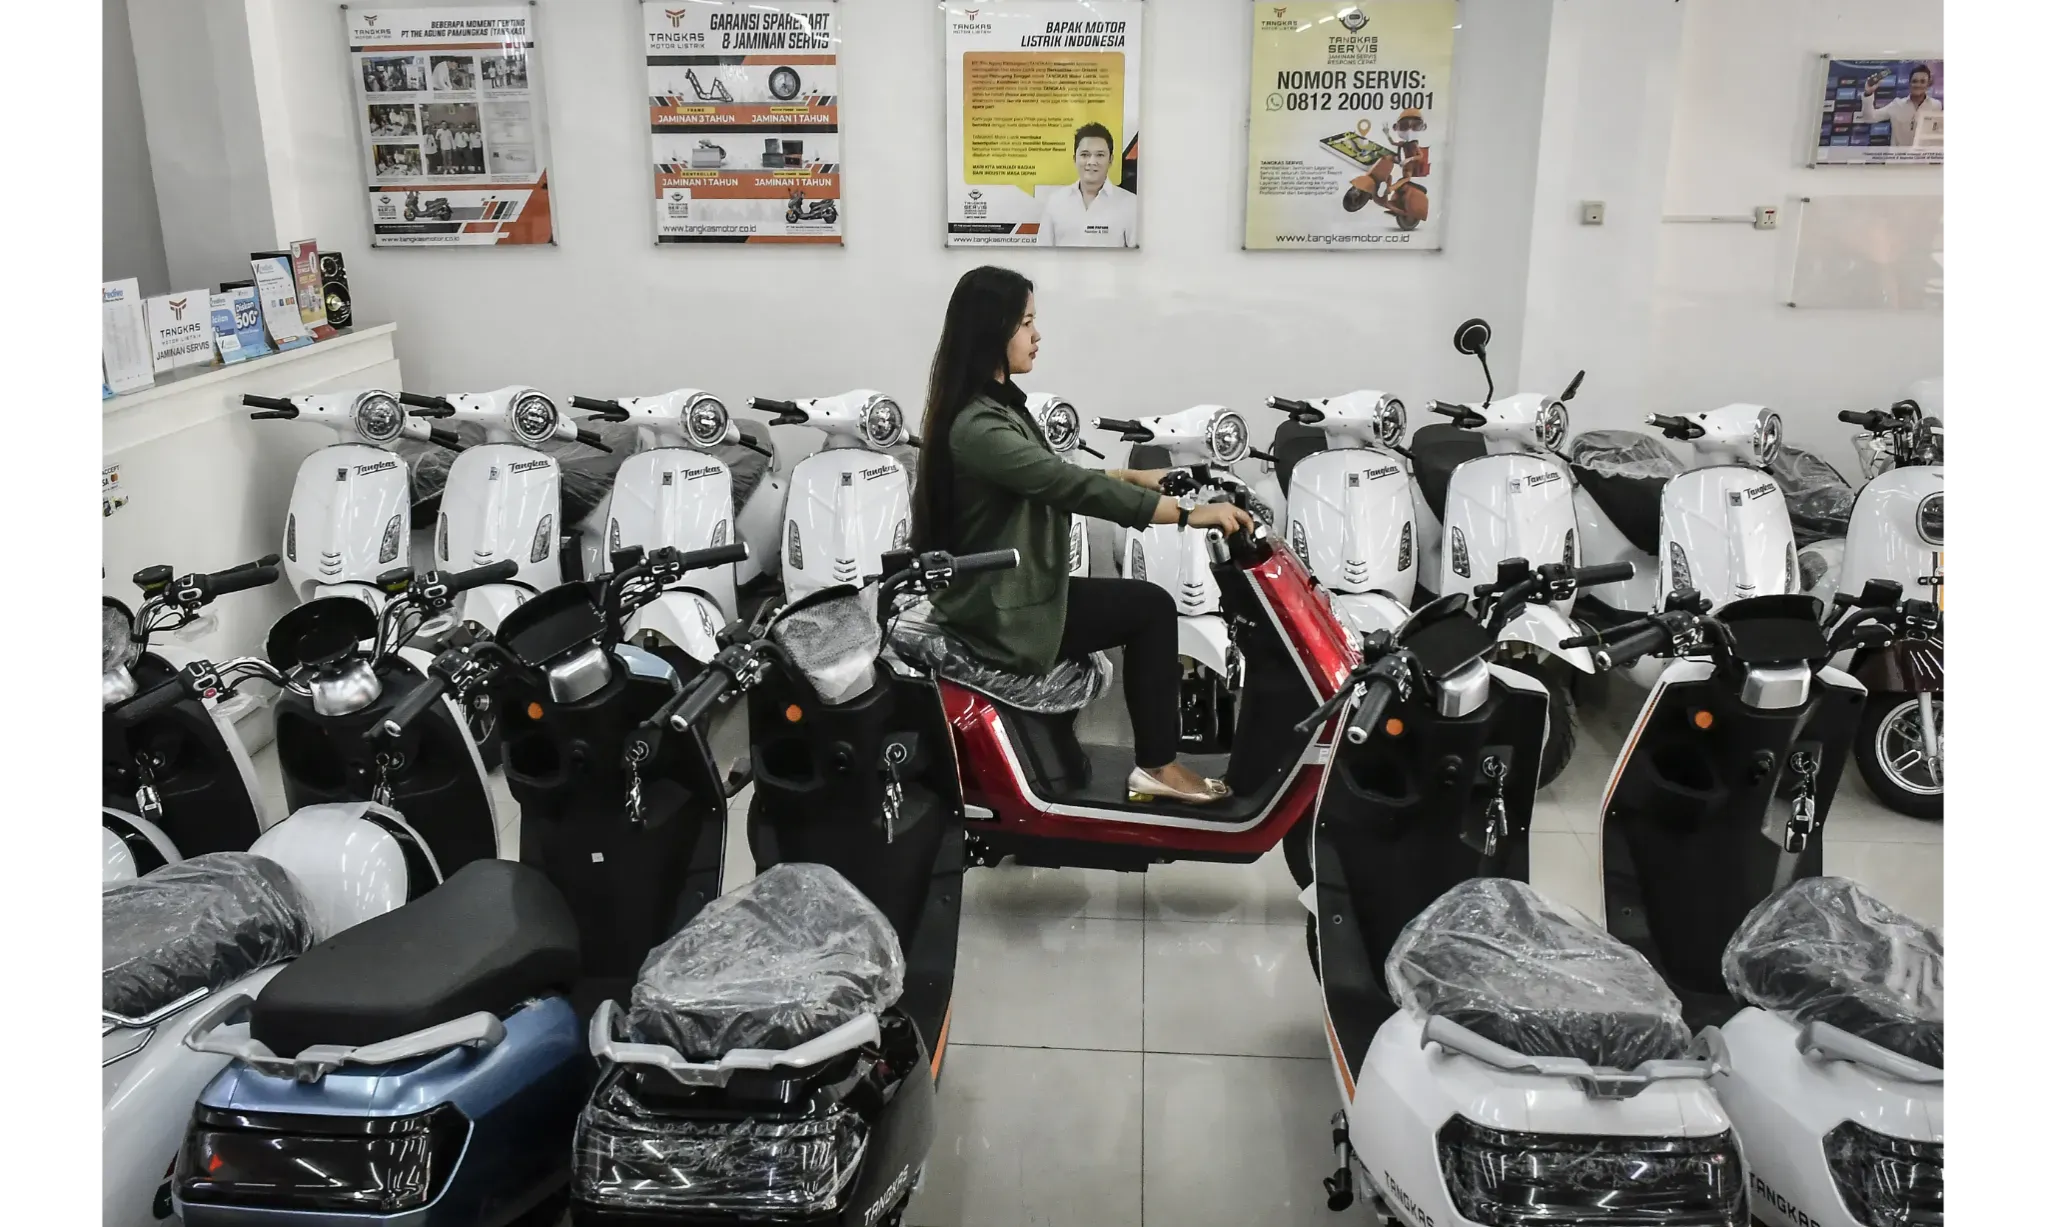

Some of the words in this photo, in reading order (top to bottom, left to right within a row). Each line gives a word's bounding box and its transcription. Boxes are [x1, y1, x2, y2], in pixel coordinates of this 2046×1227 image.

[431, 21, 464, 29] BEBERAPA
[466, 20, 495, 28] MOMENT
[710, 13, 760, 30] GARANSI
[401, 30, 409, 38] PT
[411, 30, 422, 38] THE
[424, 28, 446, 37] AGUNG
[448, 28, 488, 37] PAMUNGKAS
[1046, 22, 1083, 34] BAPAK
[1085, 22, 1126, 34] MOTOR
[649, 33, 705, 42] TANGKAS
[722, 32, 731, 49] &
[733, 32, 785, 50] JAMINAN
[788, 31, 830, 49] SERVIS
[1021, 36, 1062, 47] LISTRIK
[1064, 36, 1125, 47] INDONESIA
[1329, 36, 1378, 44] TANGKAS
[1328, 44, 1378, 54] SERVIS
[1277, 71, 1346, 90] NOMOR
[1353, 70, 1426, 89] SERVIS:
[1286, 92, 1332, 110] 0812
[1338, 92, 1384, 110] 2000
[1390, 92, 1434, 110] 9001
[658, 114, 698, 123] JAMINAN
[700, 114, 705, 123] 3
[705, 114, 735, 122] TAHUN
[752, 114, 792, 122] JAMINAN
[794, 114, 797, 122] 1
[799, 114, 829, 122] TAHUN
[662, 178, 702, 186] JAMINAN
[704, 178, 707, 186] 1
[708, 178, 738, 186] TAHUN
[754, 178, 794, 186] JAMINAN
[796, 178, 800, 186] 1
[801, 178, 832, 186] TAHUN
[663, 224, 756, 234] www.tangkasmotor.co.id
[954, 236, 1037, 244] www.tangkasmotor.co.id
[1276, 234, 1410, 244] www.tangkasmotor.co.id
[160, 323, 201, 338] TANGKAS
[157, 346, 185, 360] JAMINAN
[186, 341, 210, 353] SERVIS
[353, 461, 398, 476] Tangkas
[508, 460, 551, 474] Tangkas
[681, 466, 723, 480] Tangkas
[859, 465, 899, 481] Tangkas
[1363, 466, 1400, 480] Tangkas
[1743, 483, 1776, 500] Tangkas
[864, 1164, 909, 1226] TANGKAS
